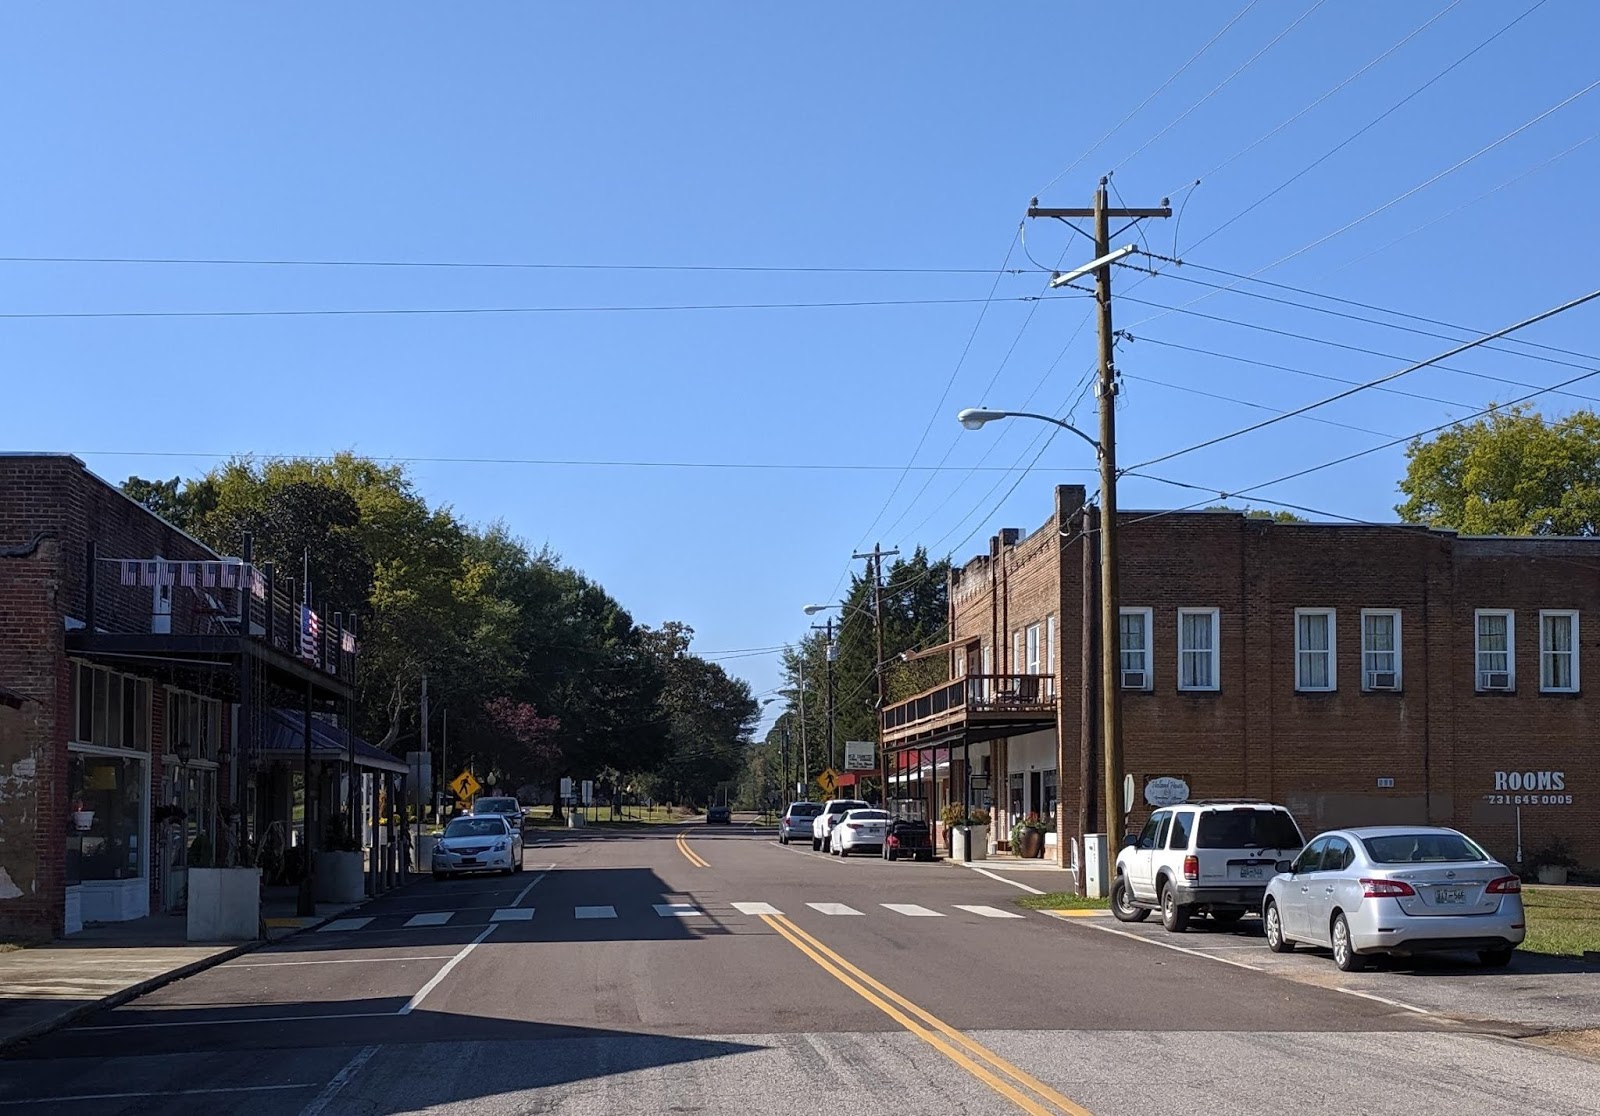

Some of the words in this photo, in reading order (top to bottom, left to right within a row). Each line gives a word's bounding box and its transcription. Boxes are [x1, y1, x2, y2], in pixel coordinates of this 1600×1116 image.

[1494, 771, 1565, 791] ROOMS
[1488, 794, 1511, 804] 231
[1514, 794, 1538, 804] 645
[1541, 794, 1573, 804] 0005
